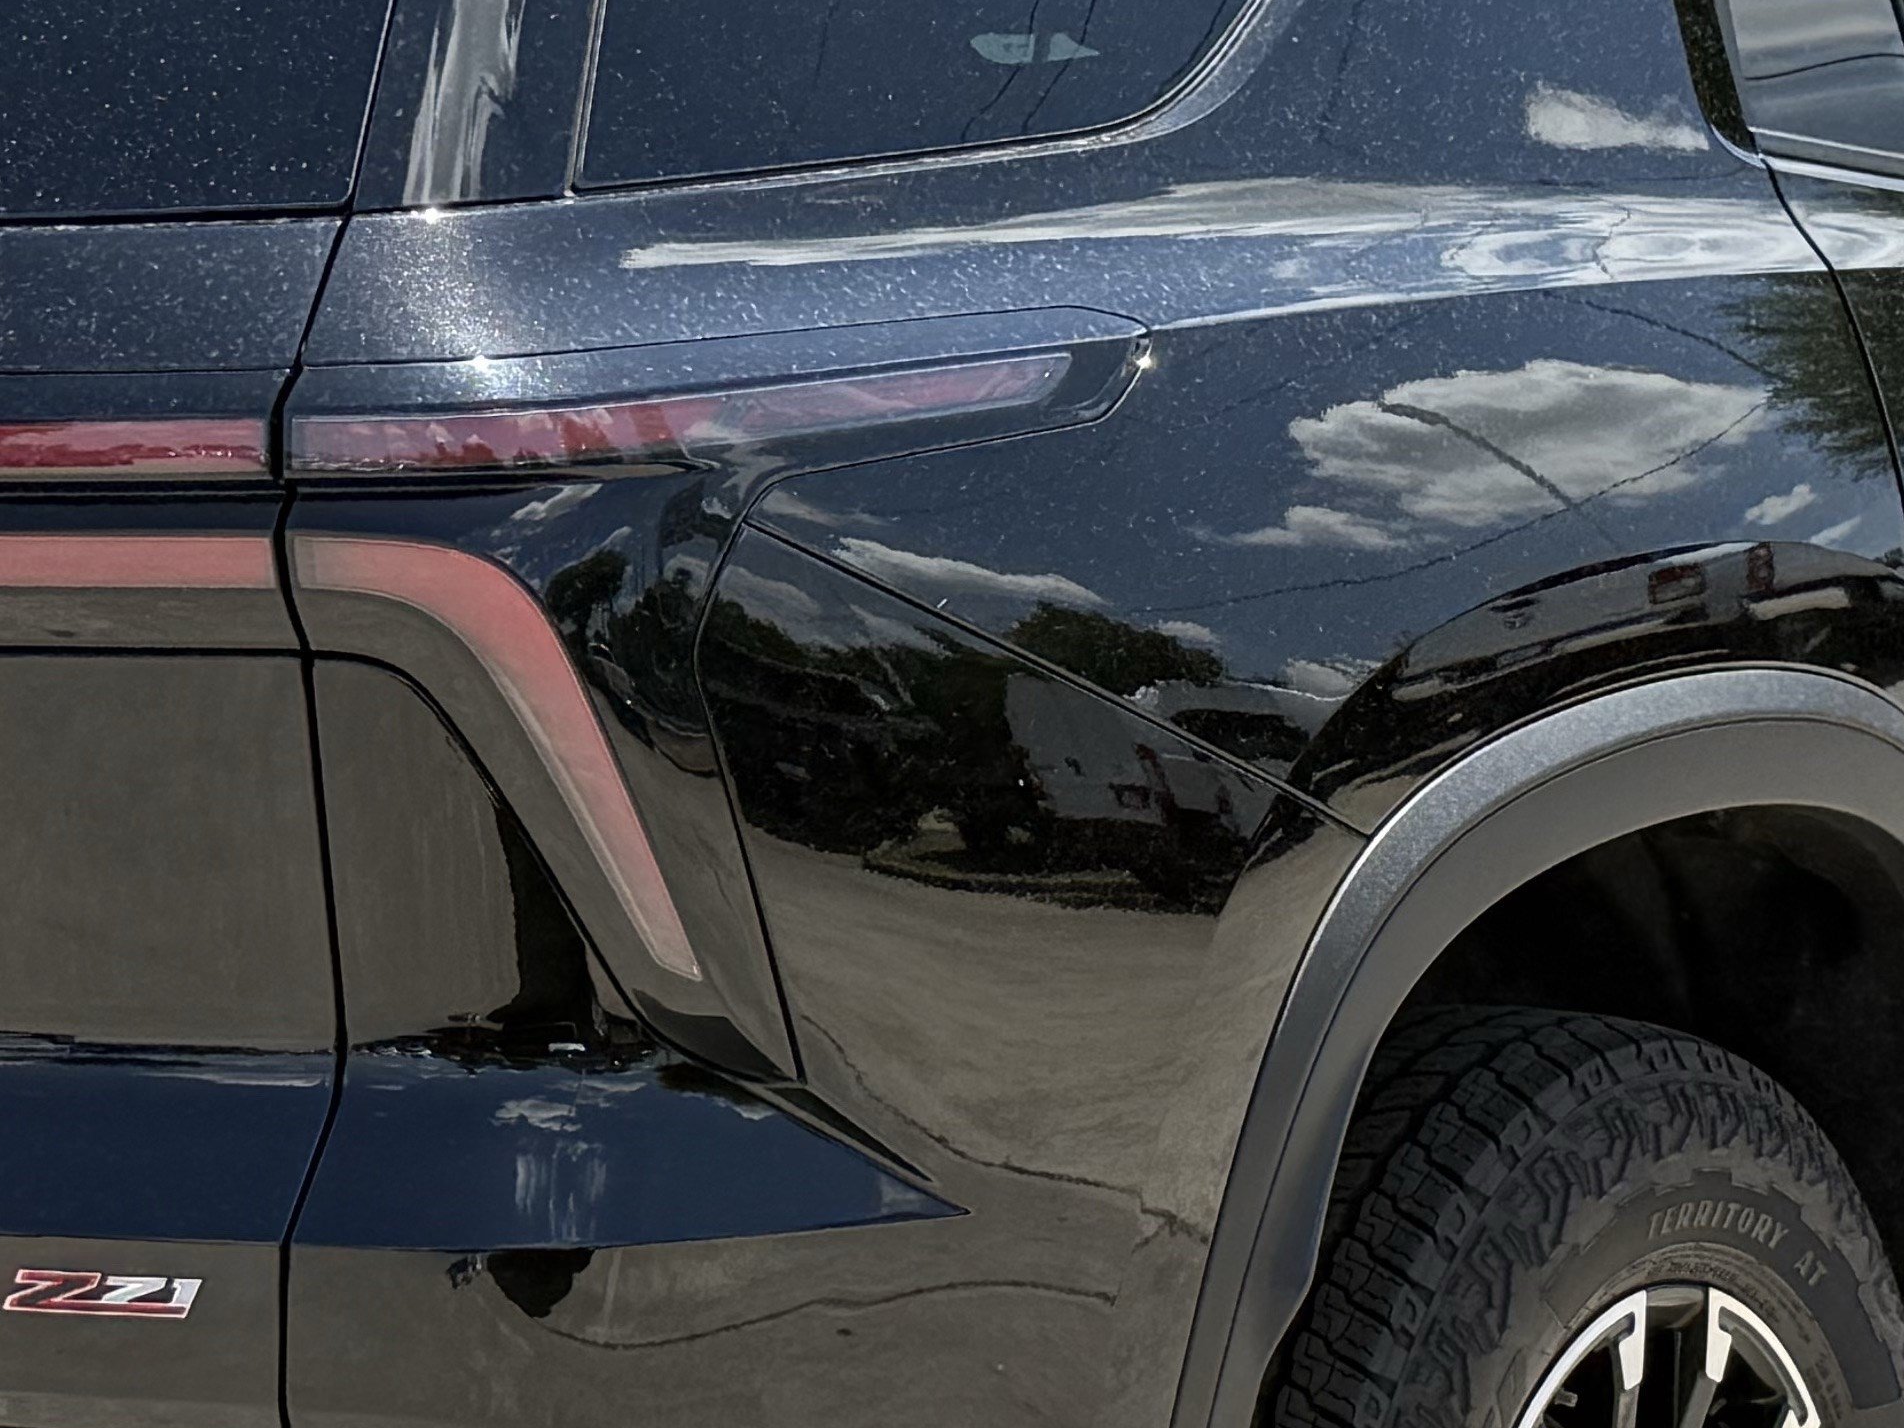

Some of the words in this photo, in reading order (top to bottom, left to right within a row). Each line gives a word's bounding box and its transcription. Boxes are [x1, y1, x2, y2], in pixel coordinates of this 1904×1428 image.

[1648, 1199, 1789, 1250] TERRITORY
[1793, 1249, 1828, 1287] AT
[2, 1268, 203, 1319] Z71
